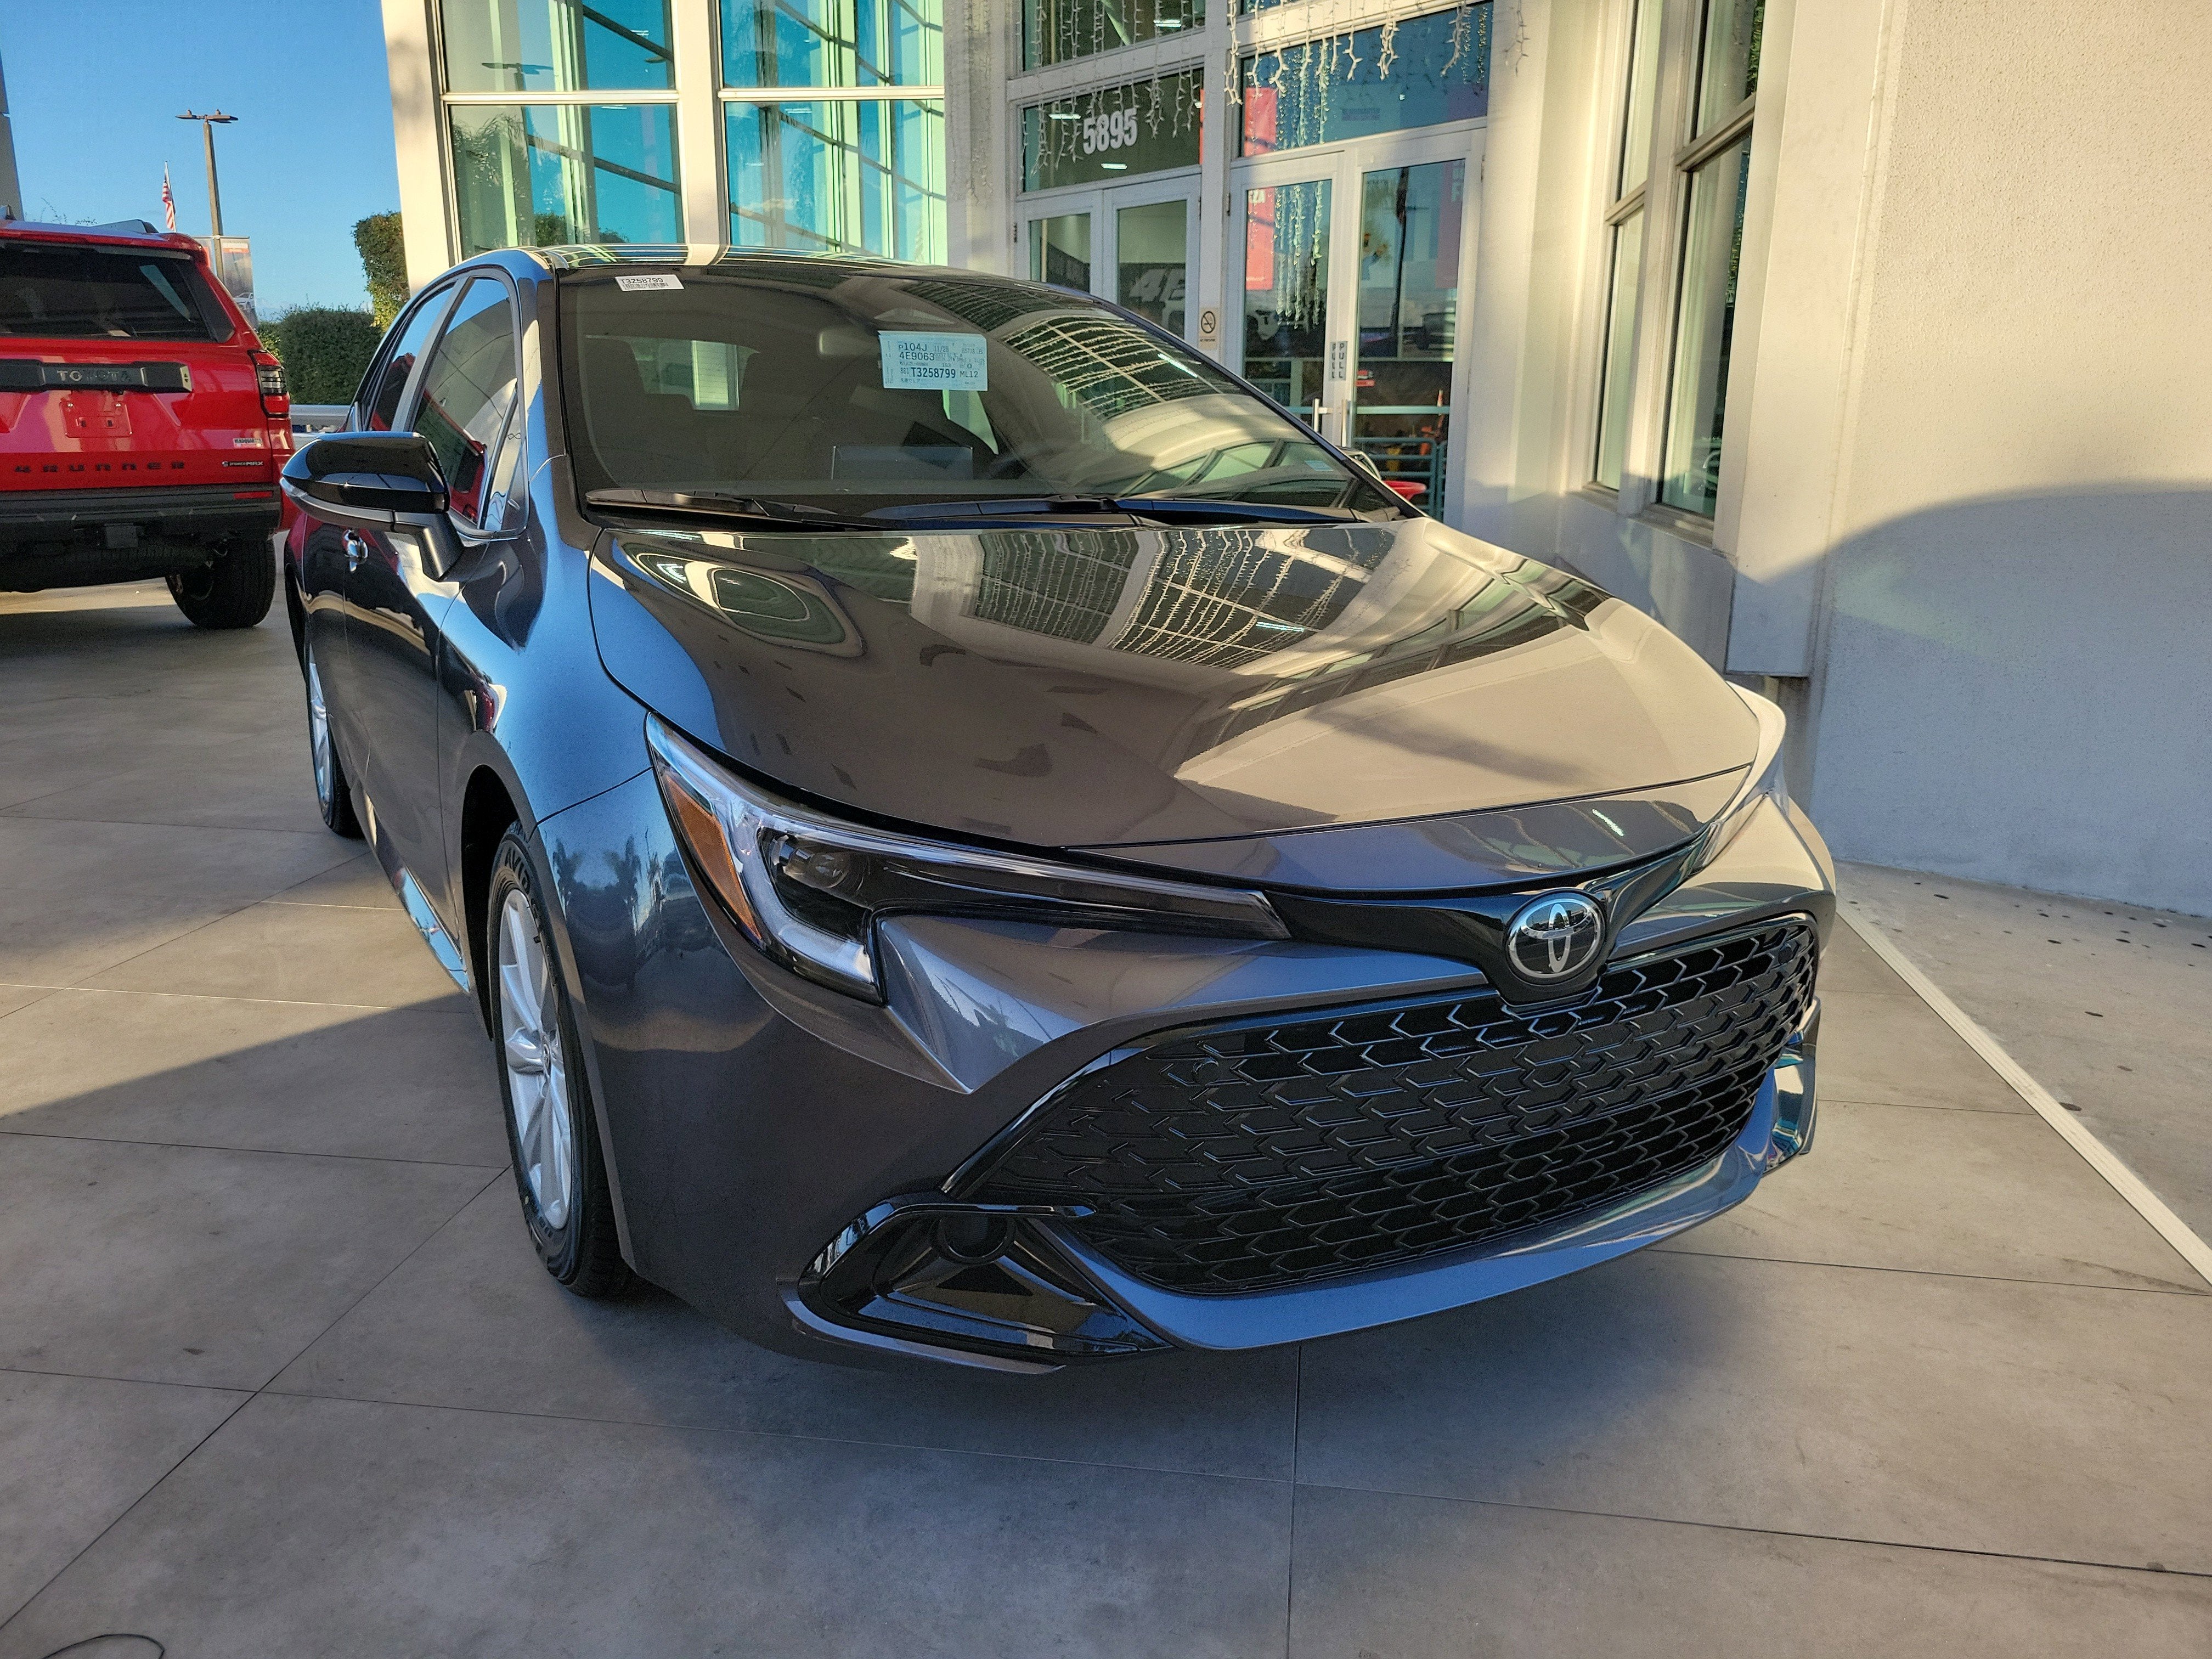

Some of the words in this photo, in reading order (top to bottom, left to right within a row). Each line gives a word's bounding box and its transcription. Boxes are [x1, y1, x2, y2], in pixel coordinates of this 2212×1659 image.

[1083, 108, 1137, 154] 5895
[899, 352, 935, 361] 4E9063
[911, 367, 956, 379] T3258799
[504, 846, 531, 895] AVID
